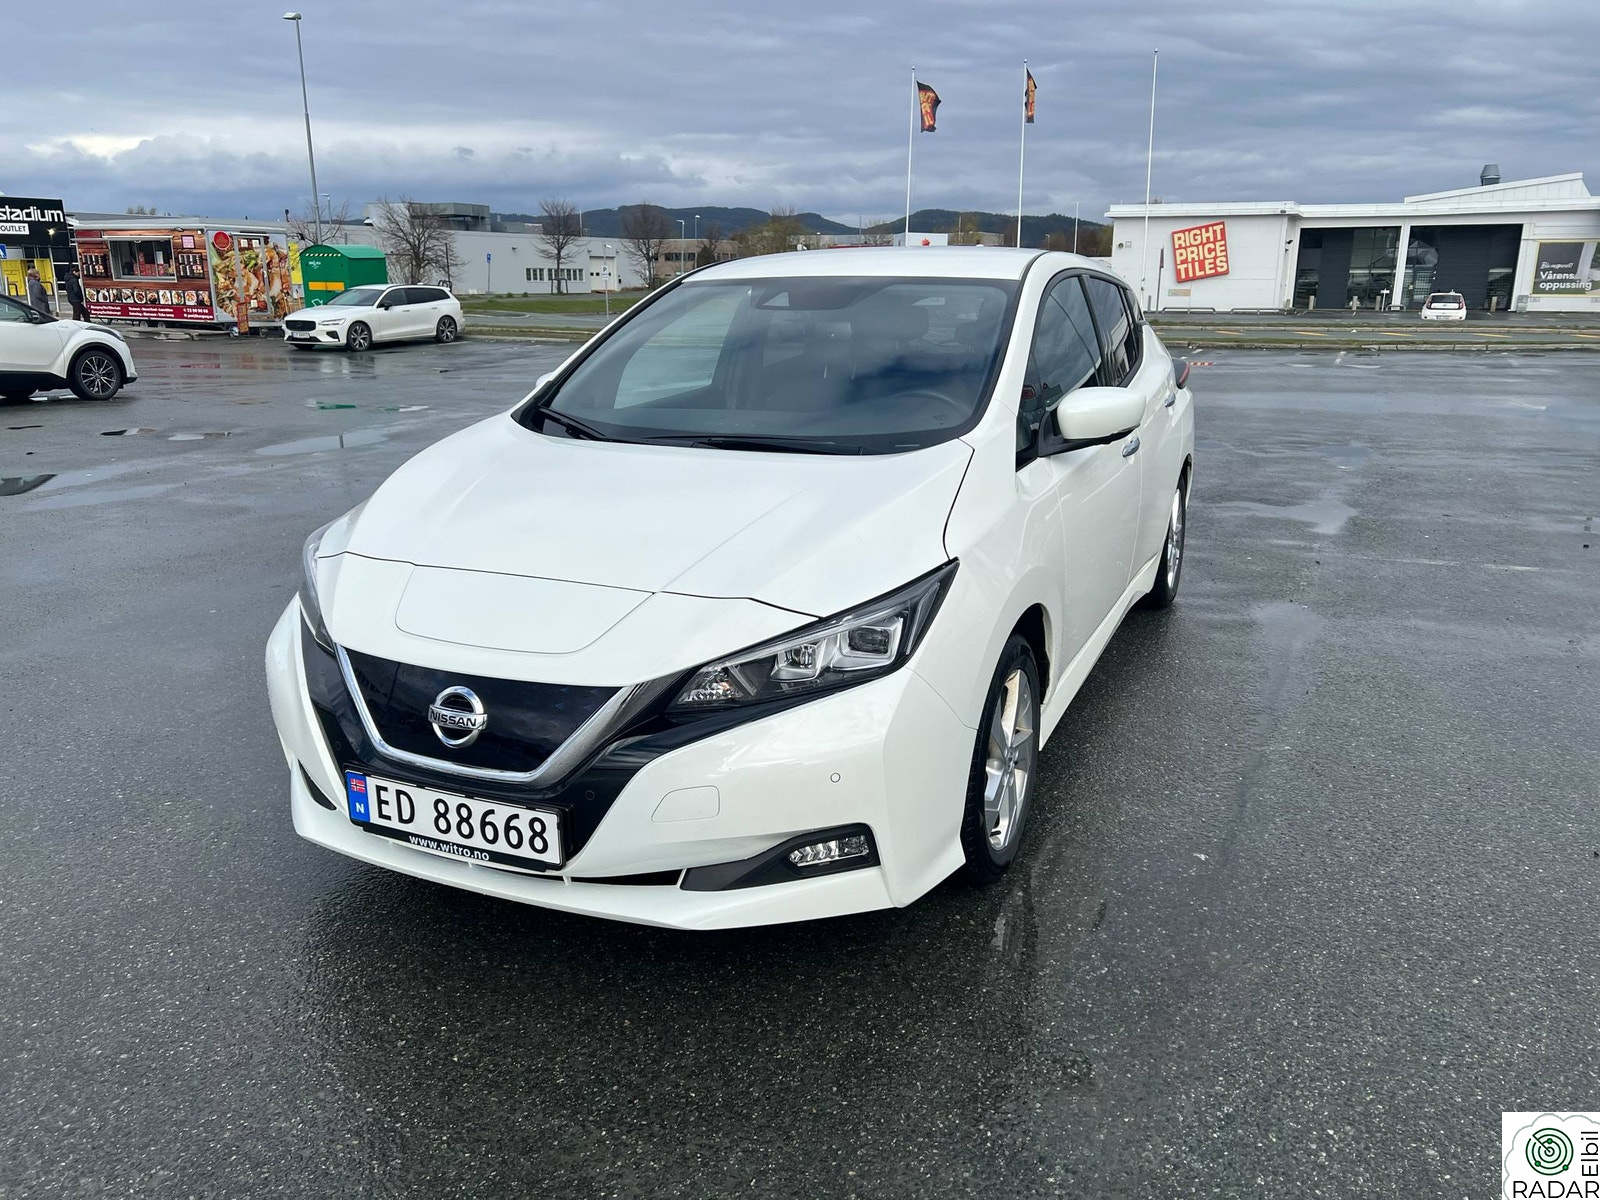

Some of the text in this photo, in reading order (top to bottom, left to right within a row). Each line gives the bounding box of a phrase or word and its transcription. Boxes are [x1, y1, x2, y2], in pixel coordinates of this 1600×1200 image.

[0, 205, 64, 222] stadium
[1173, 224, 1223, 248] RIGHT
[1175, 241, 1226, 264] PRICE
[1177, 256, 1228, 279] TILES
[1540, 271, 1575, 279] Vårens
[1540, 280, 1592, 290] oppussing
[429, 710, 477, 728] NISSAN
[355, 803, 364, 814] N
[376, 785, 549, 854] ED 88668
[409, 835, 490, 861] www.witro.no
